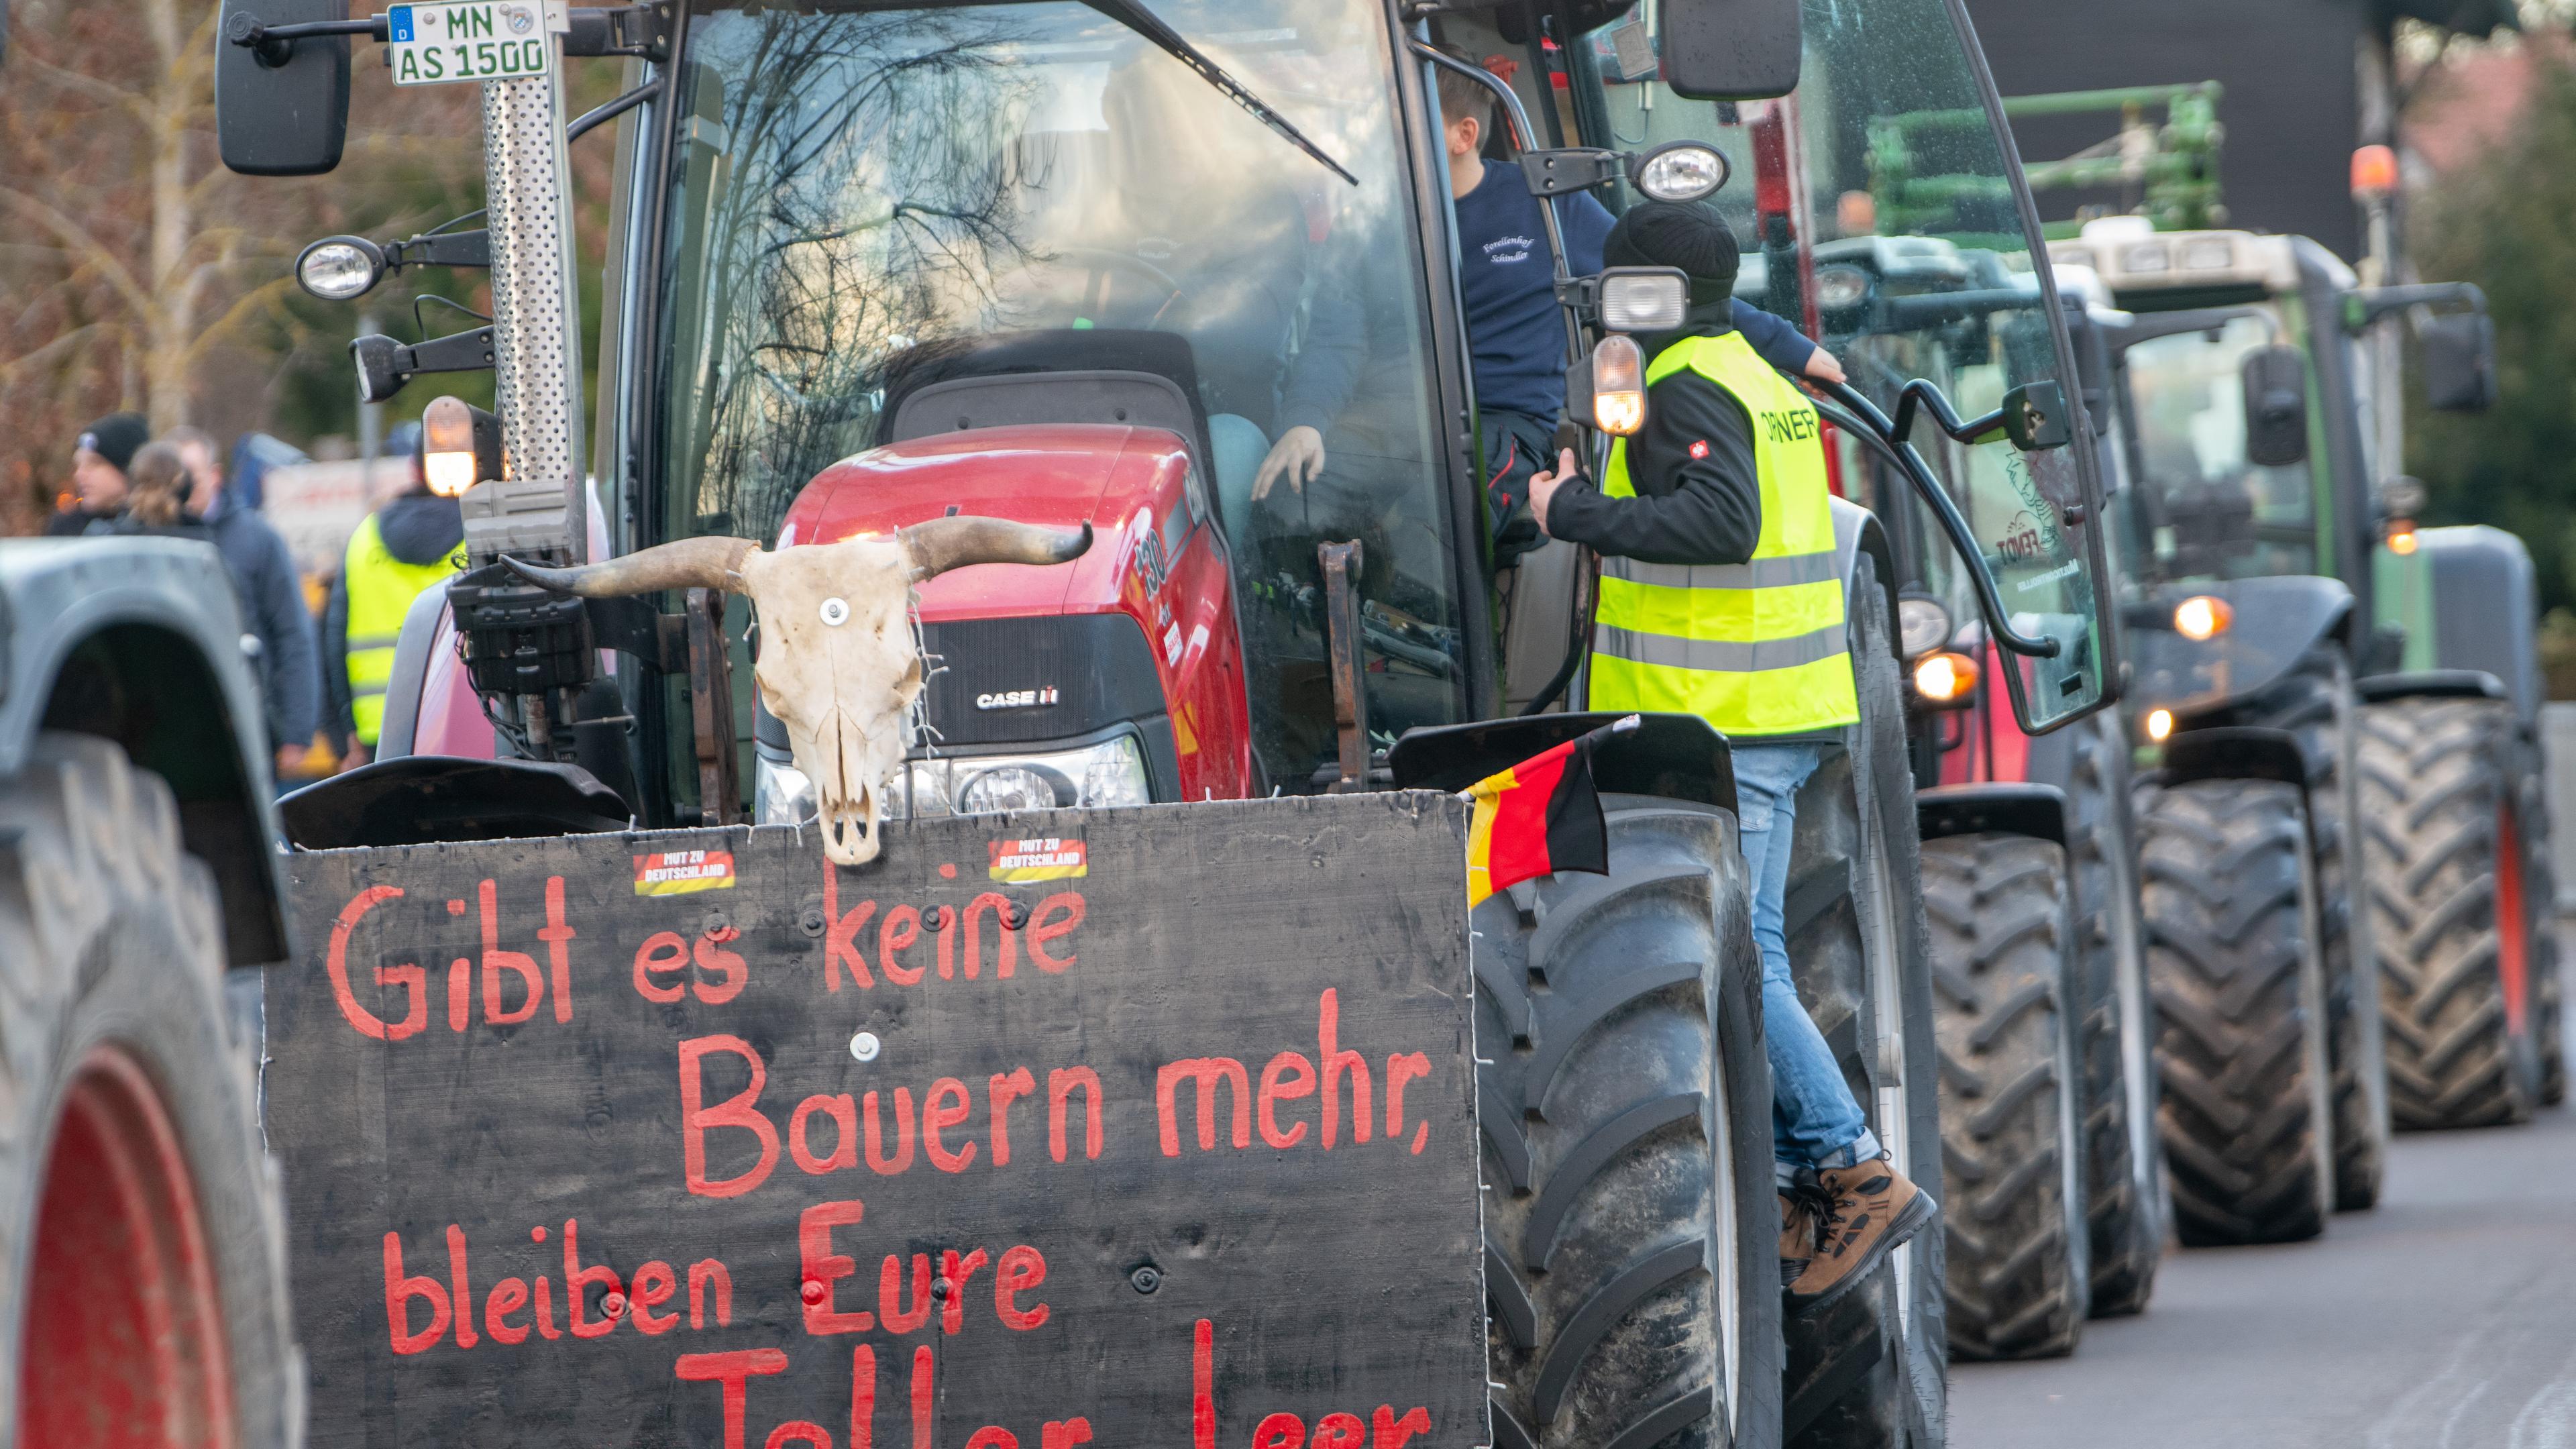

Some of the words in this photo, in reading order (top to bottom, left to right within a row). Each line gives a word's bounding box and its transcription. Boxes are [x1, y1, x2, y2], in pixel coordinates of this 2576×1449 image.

[445, 5, 493, 39] MN
[398, 28, 408, 40] D
[400, 46, 444, 80] AS
[454, 38, 543, 77] 1500
[1483, 235, 1536, 253] Forellenhof
[1490, 250, 1529, 262] Schindler
[977, 691, 1036, 710] CASE
[1018, 839, 1042, 853] MUT
[1044, 838, 1060, 851] ZU
[663, 851, 688, 865] MUT
[689, 850, 706, 863] ZU
[999, 852, 1080, 869] DEUTSCHLAND
[645, 863, 725, 882] DEUTSCHLAND
[327, 875, 576, 1040] Gibt
[633, 926, 749, 1005] es
[823, 857, 1085, 992] keine
[678, 1033, 1104, 1199] Bauern
[1157, 987, 1432, 1158] mehr,
[383, 1218, 733, 1355] bleiben
[798, 1199, 1051, 1336] Eure
